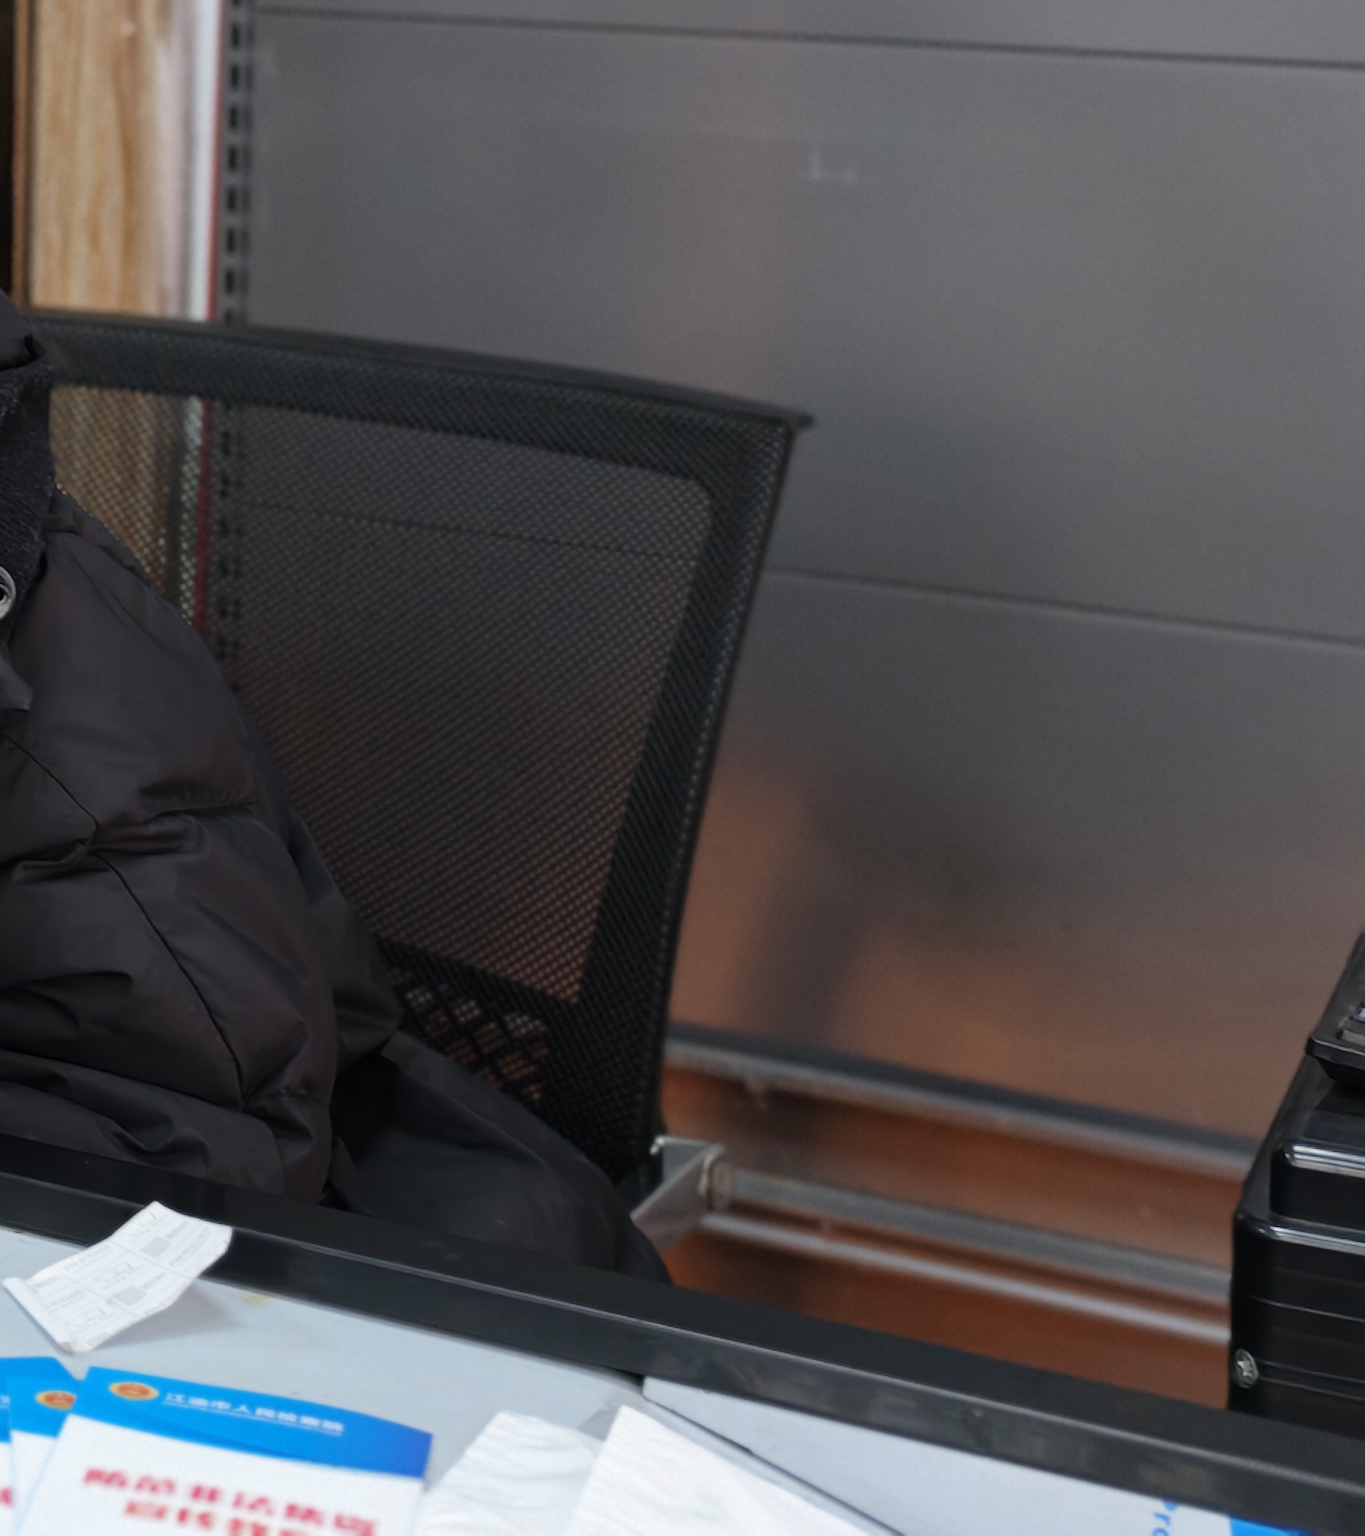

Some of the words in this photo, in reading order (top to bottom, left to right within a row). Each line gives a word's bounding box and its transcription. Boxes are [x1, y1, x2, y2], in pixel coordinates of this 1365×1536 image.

[165, 1392, 345, 1433] 江油市人民检察院
[83, 1467, 377, 1536] 防范非法集资
